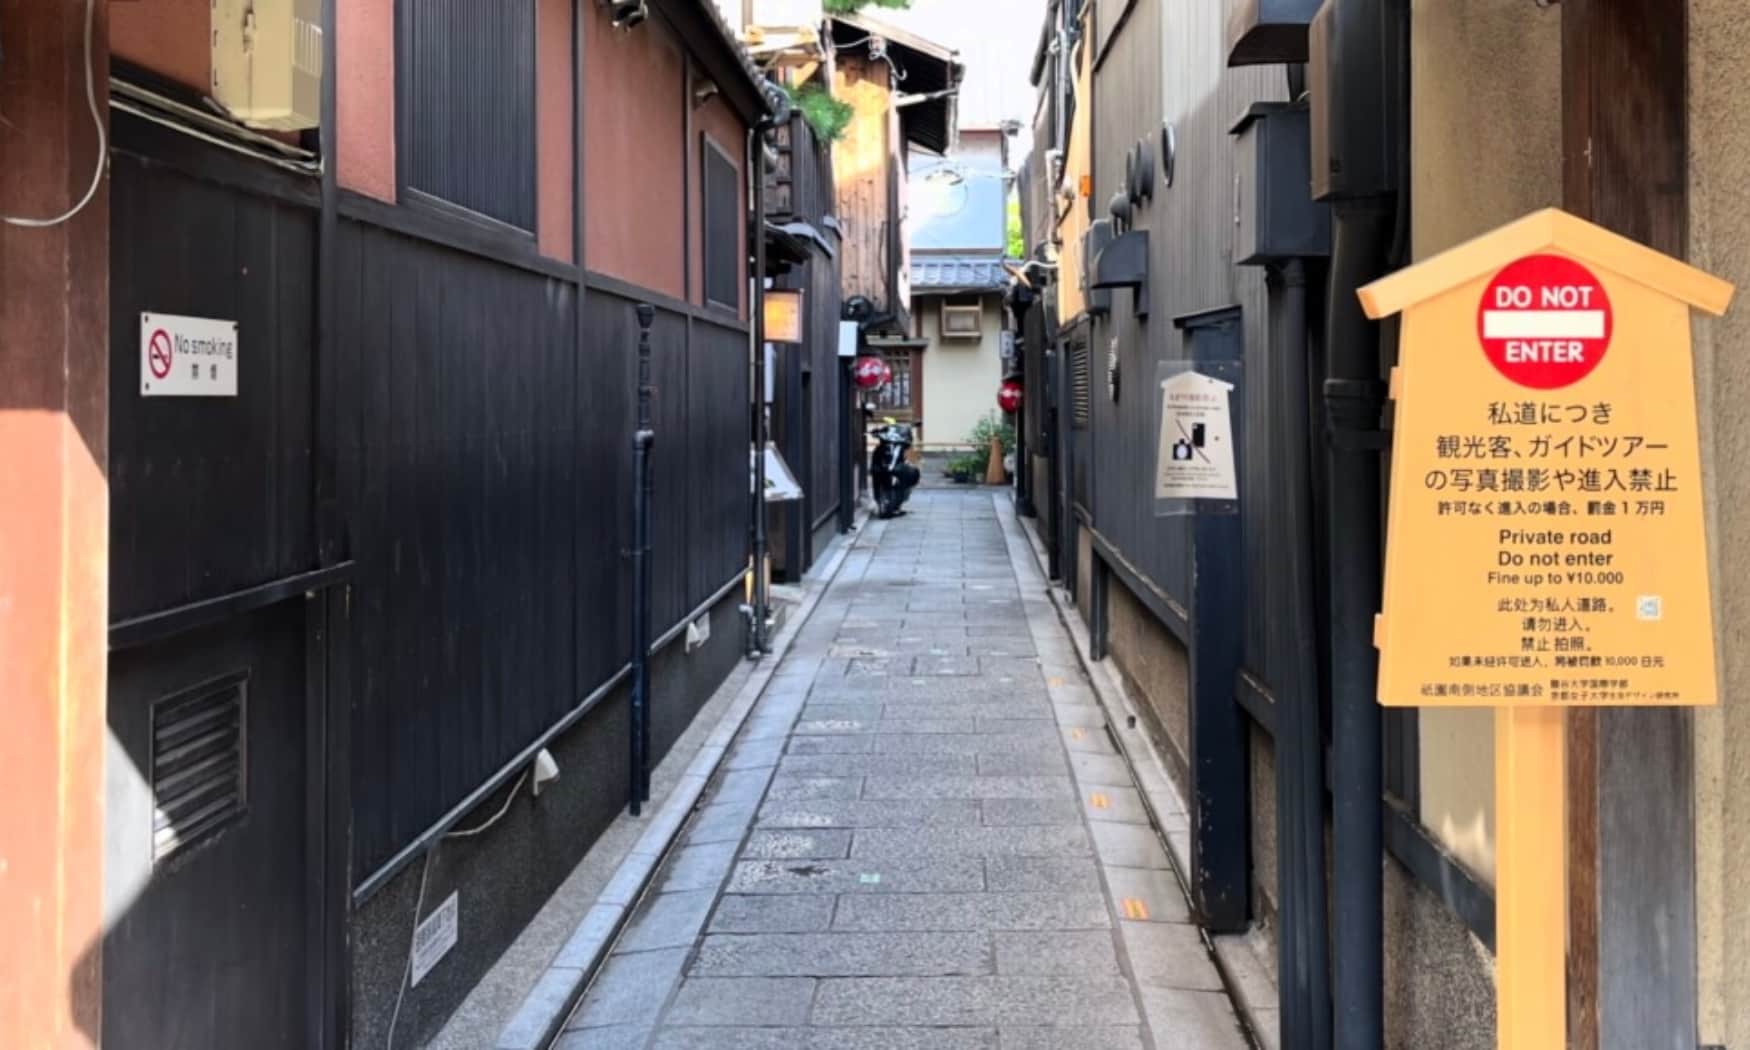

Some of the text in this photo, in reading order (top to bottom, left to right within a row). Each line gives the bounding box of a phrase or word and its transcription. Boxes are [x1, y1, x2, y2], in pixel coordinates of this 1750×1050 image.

[1496, 286, 1593, 307] DO NOT
[174, 333, 233, 360] No smoking
[1506, 341, 1584, 362] ENTER
[1488, 402, 1612, 425] 私道につき
[1437, 435, 1669, 459] 観光客、ガイドツアー
[1425, 468, 1678, 493] の写真撮影や進入禁止
[1499, 528, 1612, 545] Private road
[1498, 551, 1614, 567] Do not enter
[1487, 571, 1520, 585] Fine
[1524, 574, 1543, 587] up
[1548, 572, 1562, 585] to
